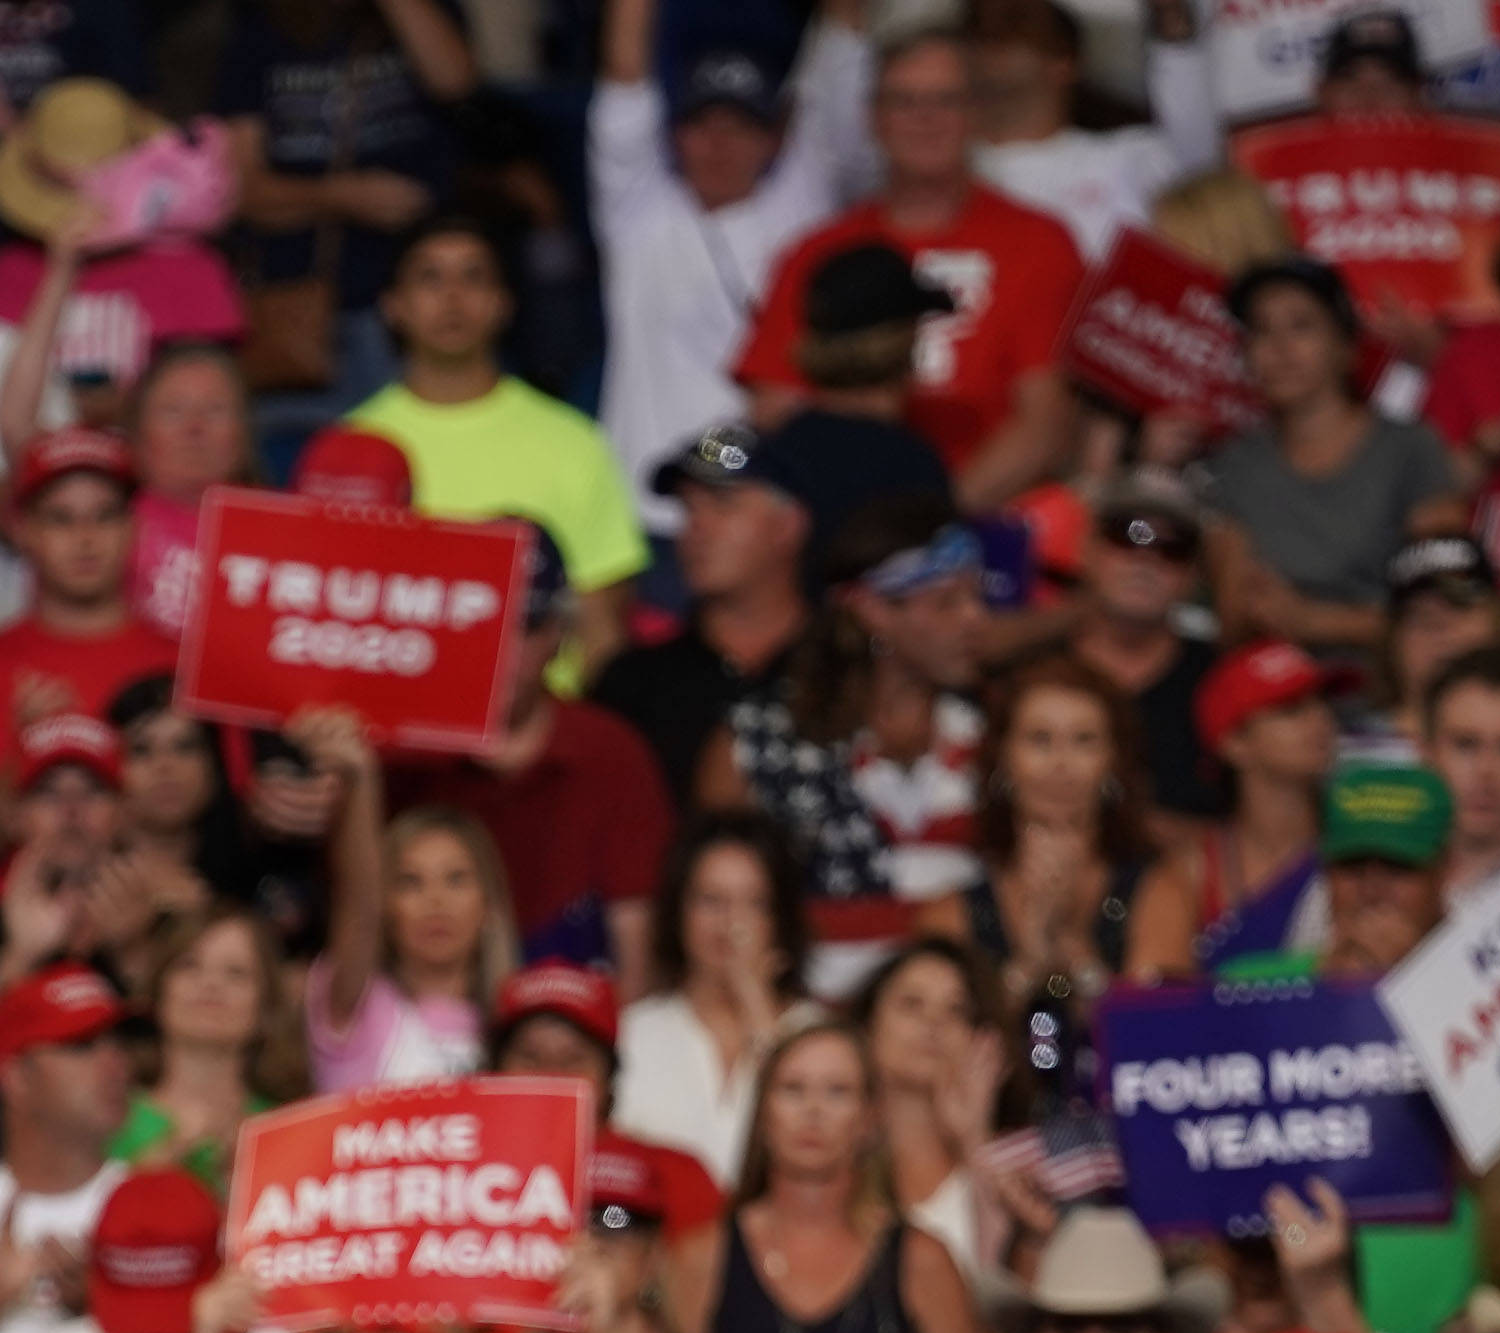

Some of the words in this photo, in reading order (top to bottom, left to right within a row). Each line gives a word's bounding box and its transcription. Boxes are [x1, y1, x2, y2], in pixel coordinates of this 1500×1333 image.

[216, 549, 504, 635] TRUMP
[268, 614, 438, 678] 2020
[1111, 1052, 1262, 1118] FOUR
[1268, 1039, 1426, 1098] MORE
[331, 1112, 484, 1170] MAKE
[1173, 1106, 1374, 1174] YEARS!
[242, 1167, 574, 1242] AMERICA
[408, 1225, 574, 1281] AGAIN
